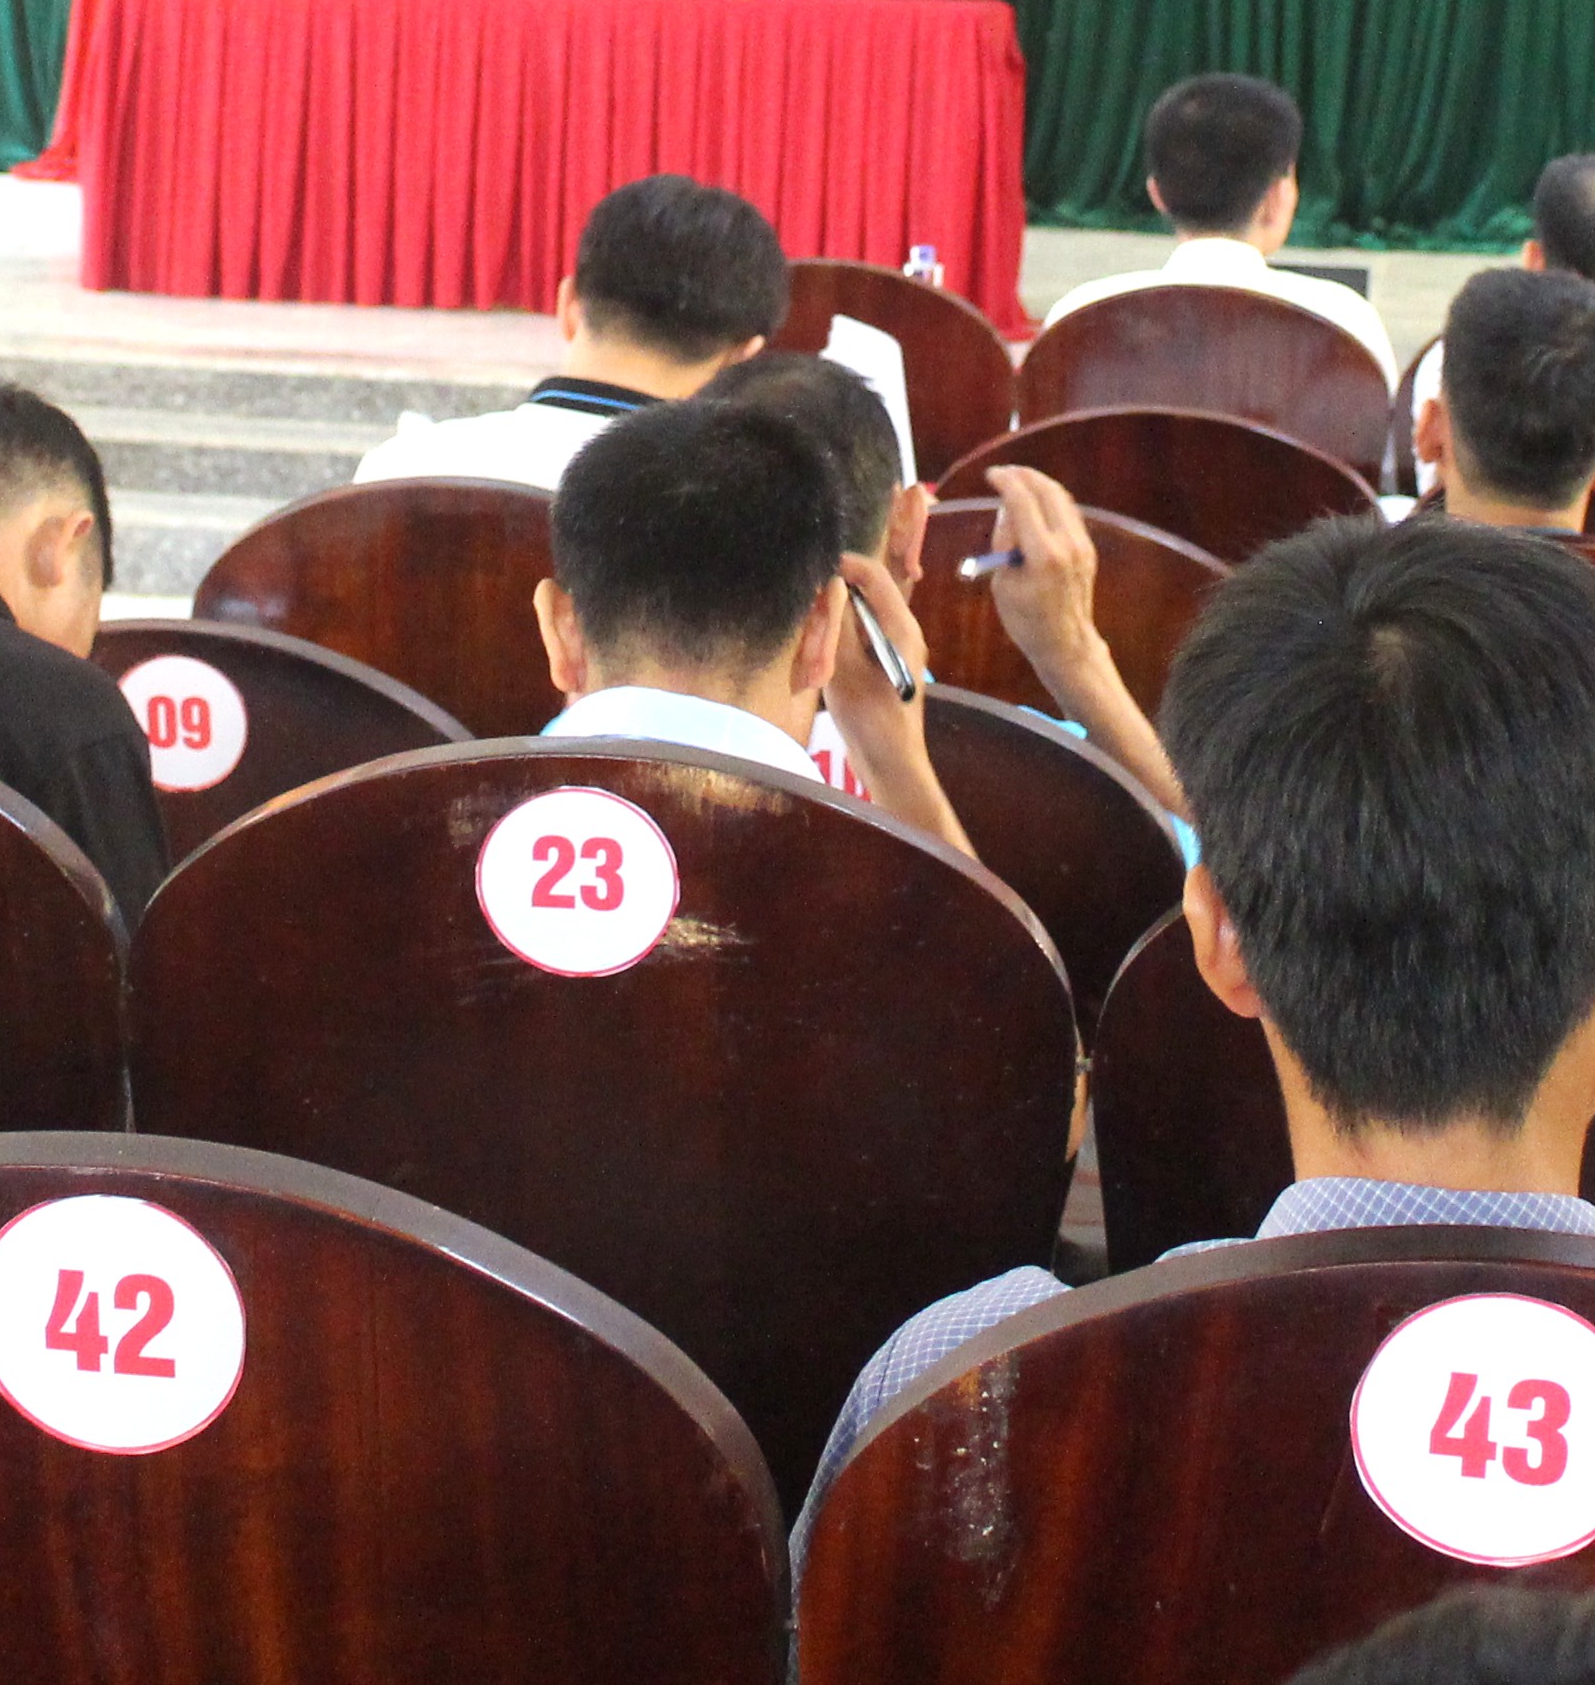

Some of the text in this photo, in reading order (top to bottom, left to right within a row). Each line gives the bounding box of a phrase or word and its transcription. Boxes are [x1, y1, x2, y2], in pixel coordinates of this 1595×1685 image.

[147, 694, 212, 750] 09
[532, 835, 625, 912] 23
[45, 1269, 176, 1378] 42
[1429, 1371, 1572, 1486] 43
